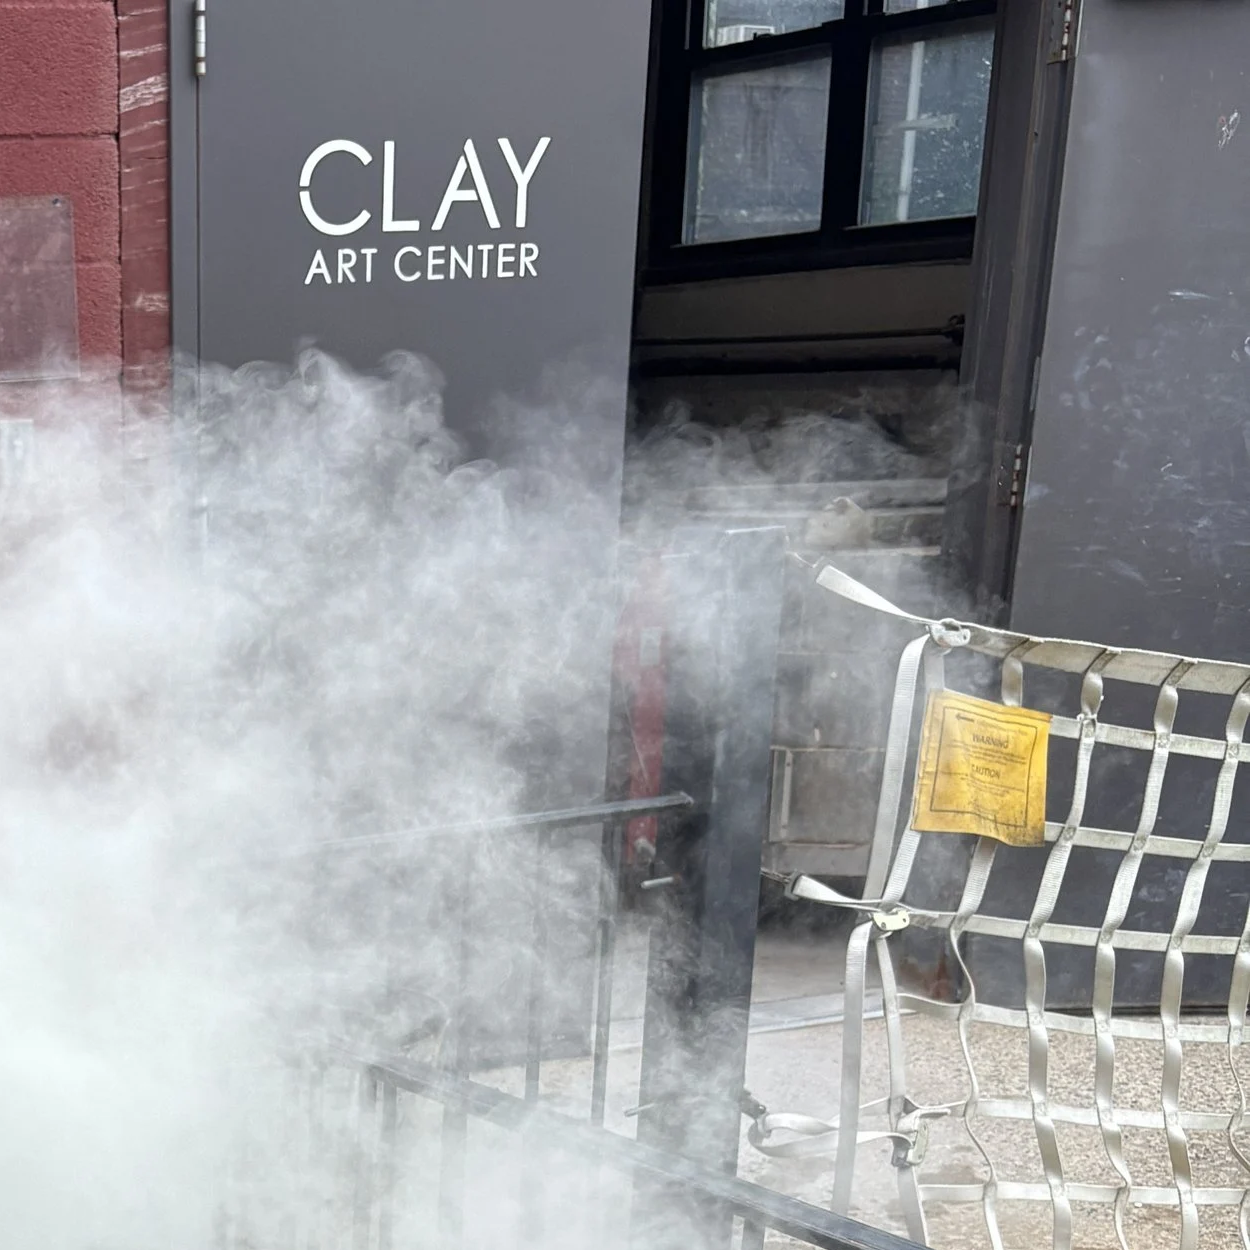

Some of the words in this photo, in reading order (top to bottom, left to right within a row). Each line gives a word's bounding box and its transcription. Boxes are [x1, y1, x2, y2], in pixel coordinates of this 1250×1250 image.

[299, 136, 551, 236] CLAY
[304, 248, 378, 285] ART
[394, 242, 540, 282] CENTER
[972, 733, 1009, 749] WARNING
[971, 763, 1000, 780] CAUTION
